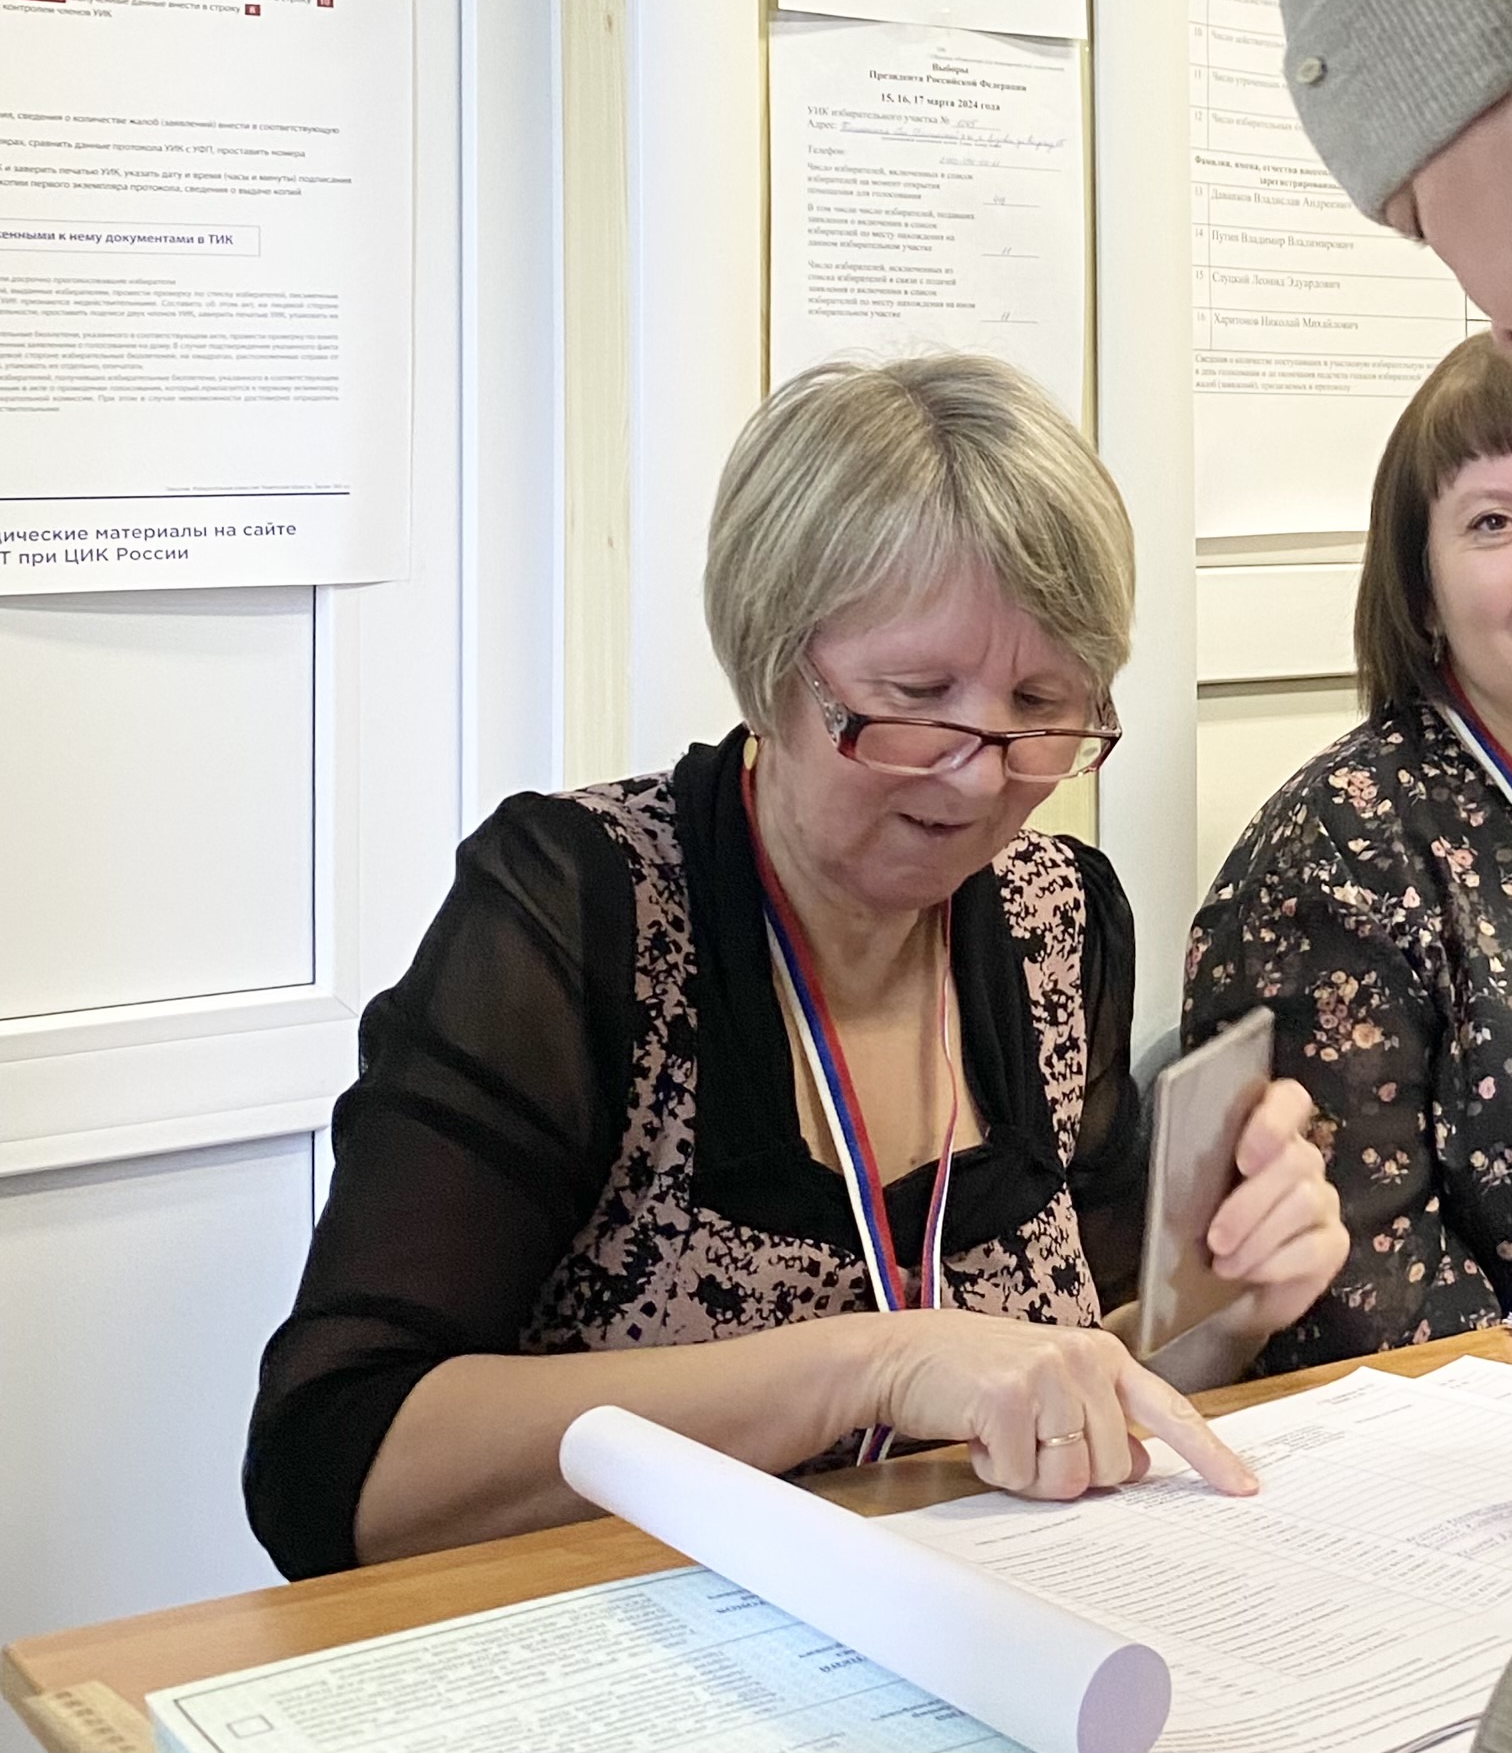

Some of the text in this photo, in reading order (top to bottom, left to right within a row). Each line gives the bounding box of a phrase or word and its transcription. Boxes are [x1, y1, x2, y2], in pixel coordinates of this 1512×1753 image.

[932, 63, 969, 75] Выборы
[869, 70, 1027, 92] Президента Российской Федерации
[881, 93, 894, 103] 15,
[914, 96, 924, 104] 17
[927, 97, 955, 109] марта
[958, 99, 978, 109] 2024
[981, 101, 1000, 111] года
[1254, 193, 1300, 207] Владислав
[70, 233, 102, 244] нему
[105, 232, 194, 244] документами
[198, 236, 204, 244] в
[208, 234, 233, 245] ТИК
[1212, 230, 1239, 244] Путин
[1242, 232, 1285, 248] Владимир
[1288, 236, 1354, 250] Владимирович
[1212, 272, 1249, 285] Слуцкий
[1288, 278, 1341, 290] Эдуардович
[0, 523, 297, 544] ические материалы на сайте
[19, 552, 57, 567] при
[65, 548, 109, 565] ЦИК
[117, 547, 189, 562] России
